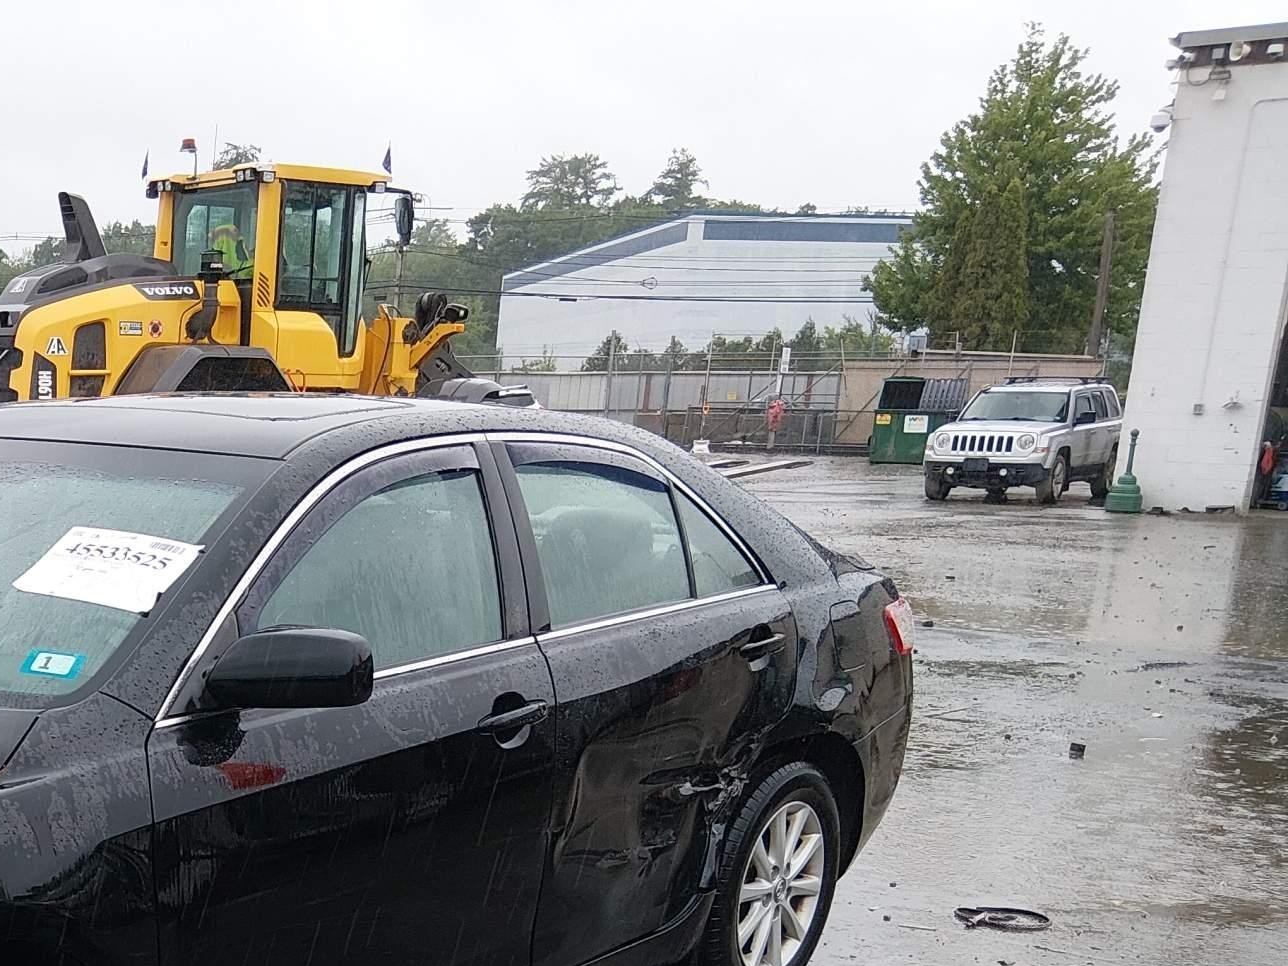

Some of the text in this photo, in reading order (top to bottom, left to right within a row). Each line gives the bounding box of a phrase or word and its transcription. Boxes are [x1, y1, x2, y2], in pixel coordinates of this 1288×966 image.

[142, 286, 194, 296] VOLVO
[38, 370, 53, 400] L90H
[65, 541, 173, 571] 45533525
